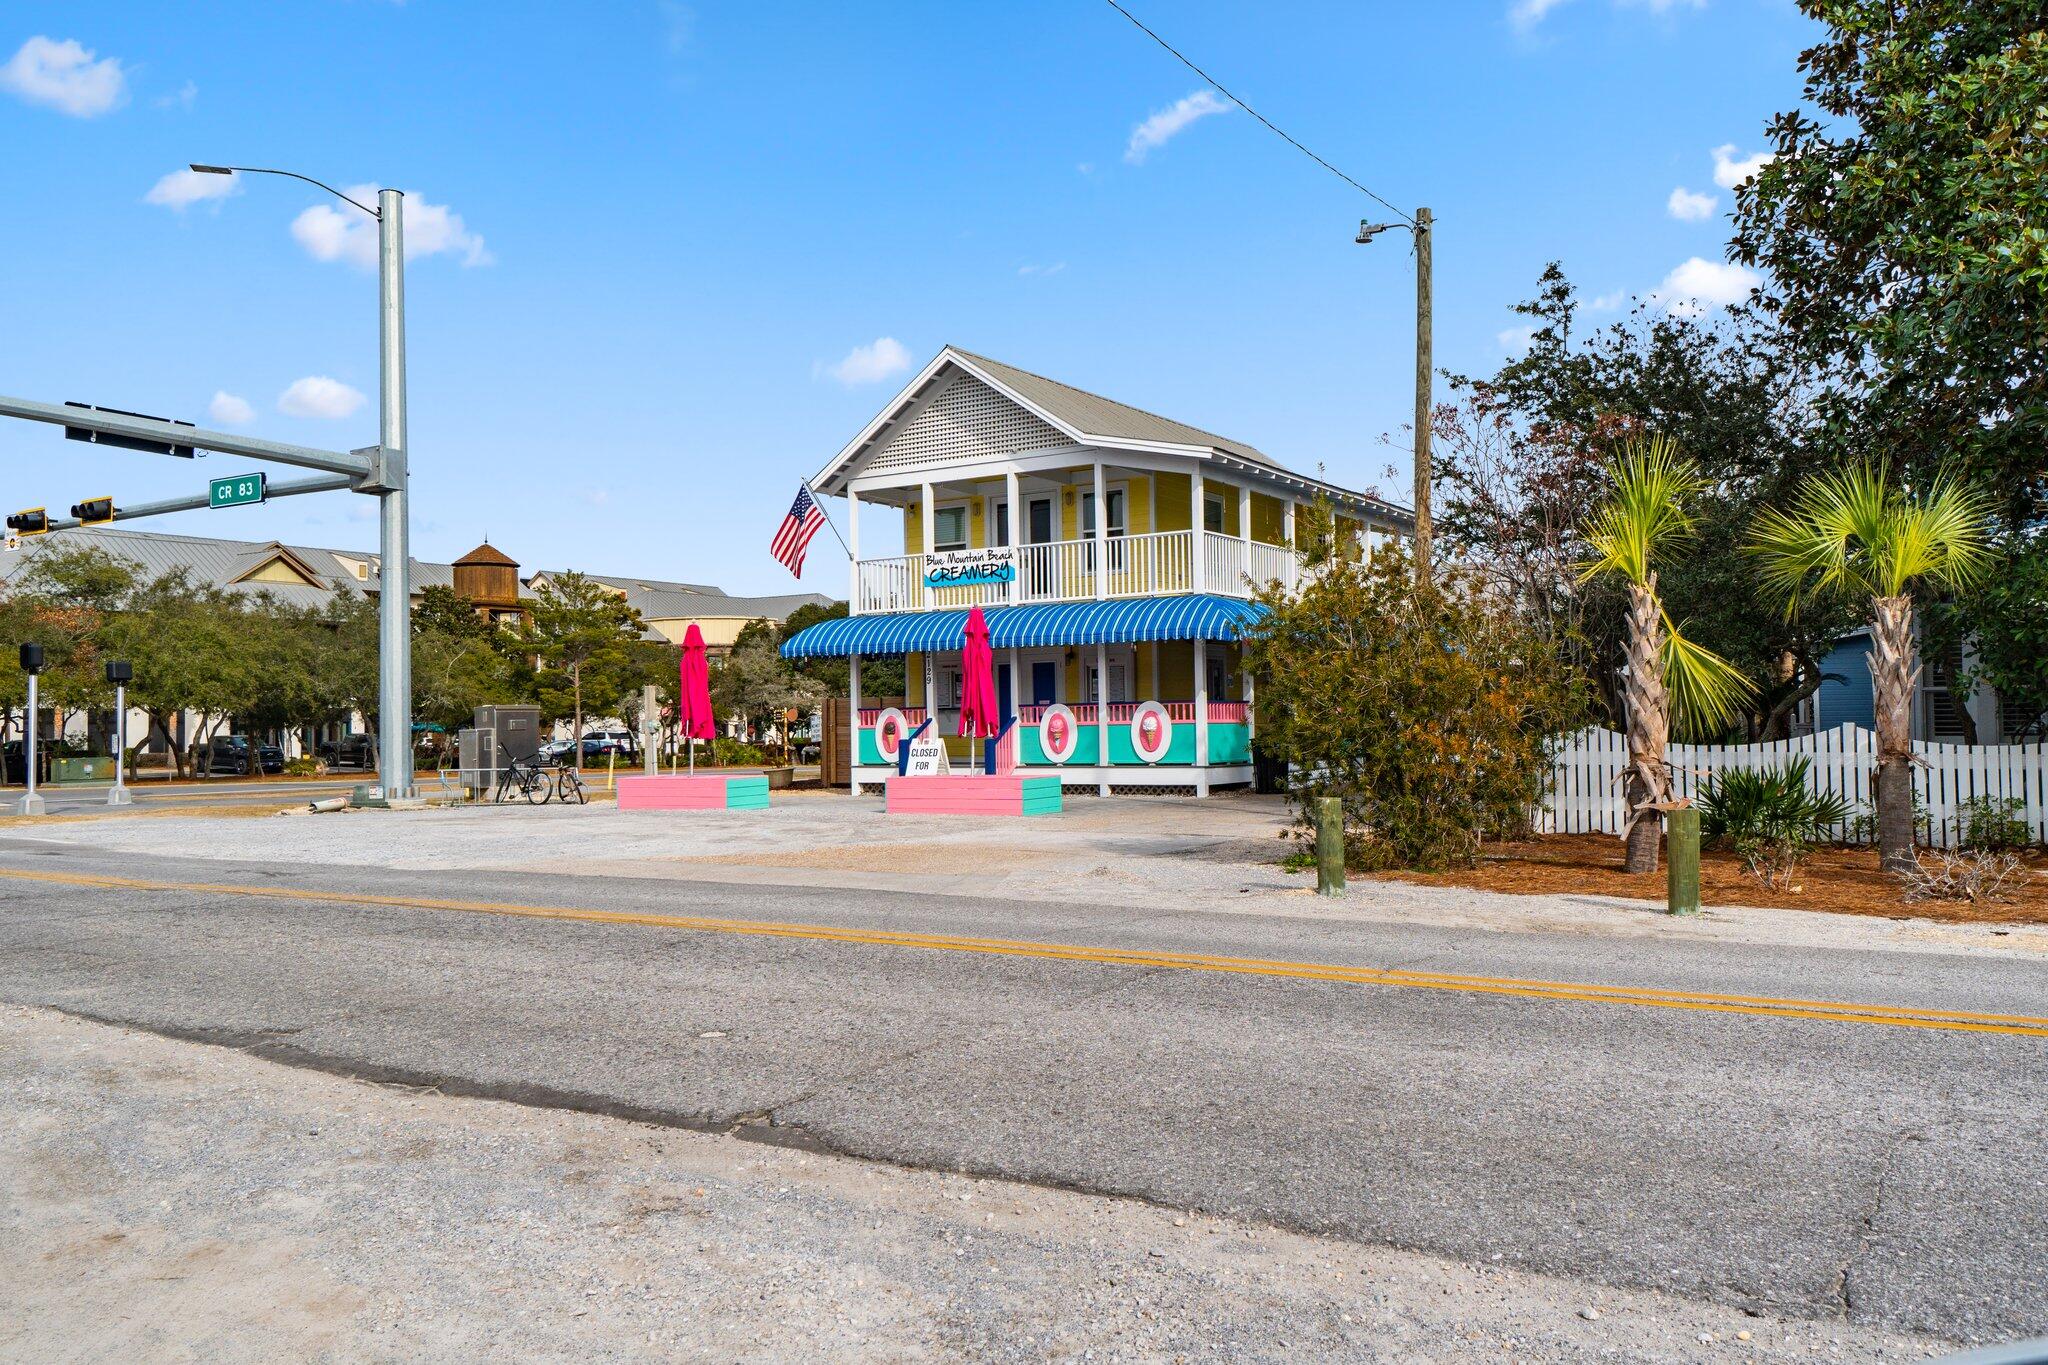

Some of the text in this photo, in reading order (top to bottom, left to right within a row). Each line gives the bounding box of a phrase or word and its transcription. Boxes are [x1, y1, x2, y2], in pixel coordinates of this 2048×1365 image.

[218, 482, 253, 499] CR 83
[925, 549, 1014, 566] Blue Mountain Beach
[929, 560, 1010, 582] CREAMERY
[911, 748, 939, 757] CLOSED
[915, 761, 930, 770] FOR
